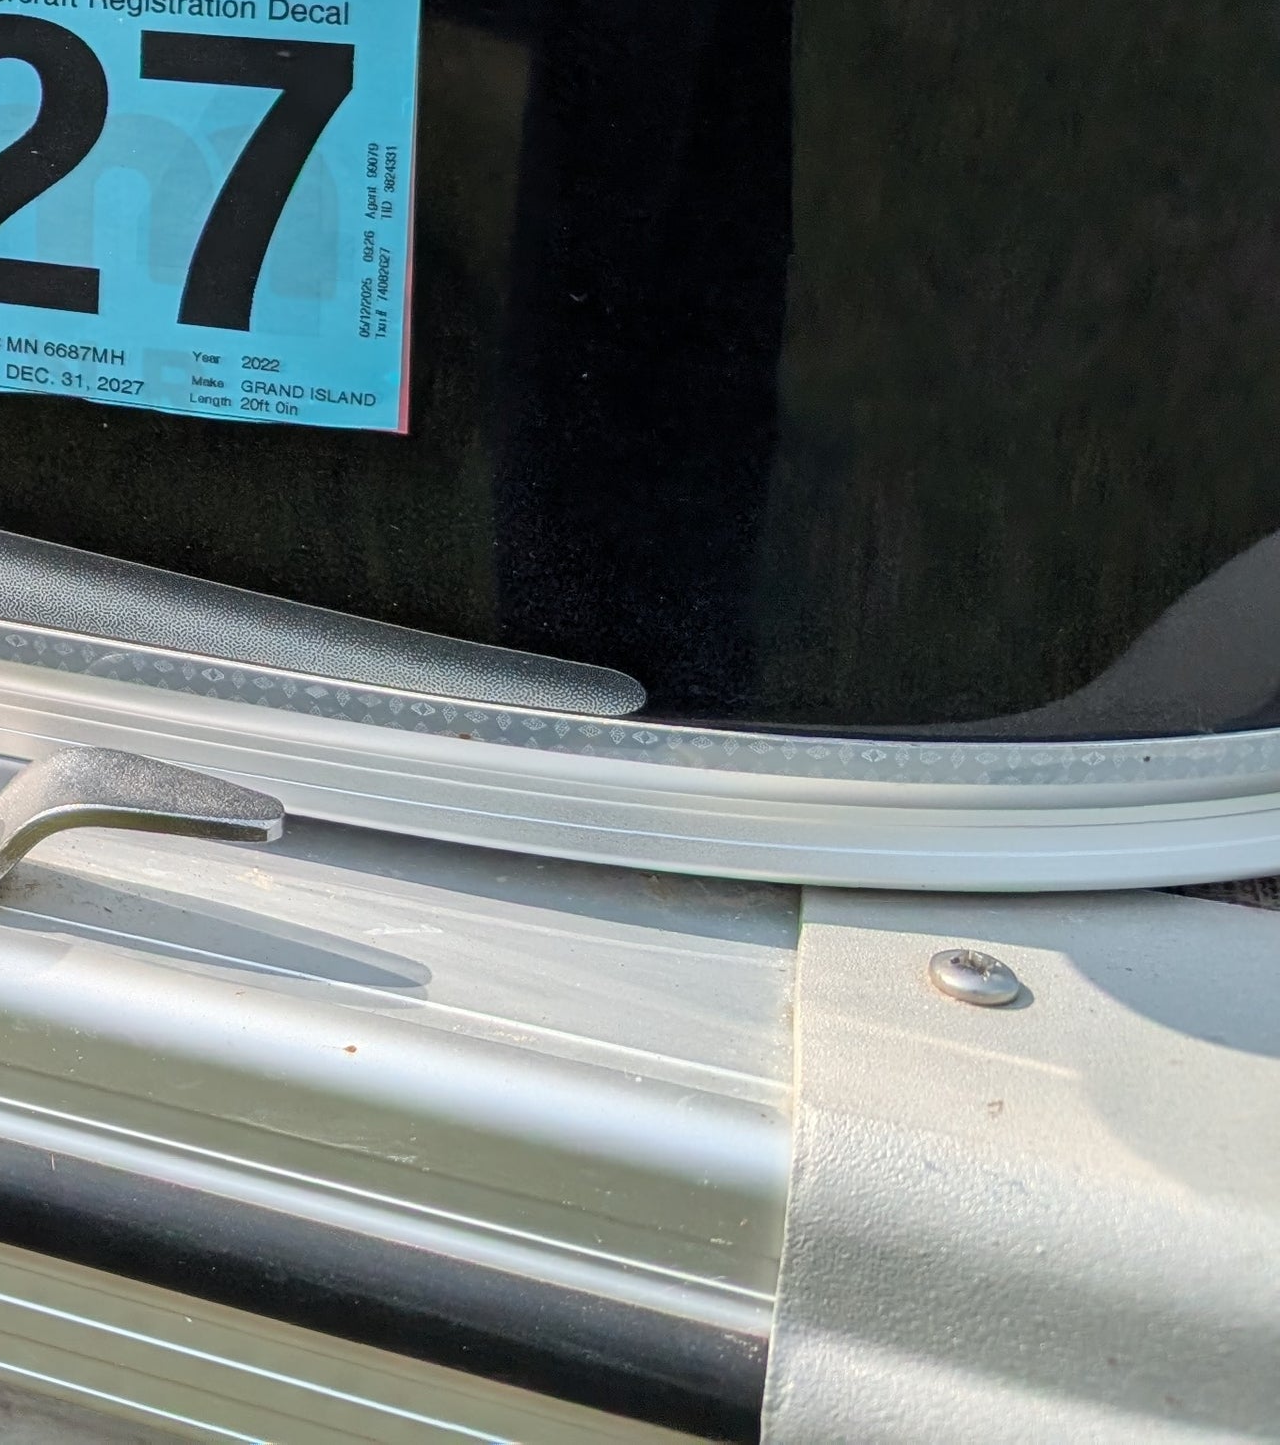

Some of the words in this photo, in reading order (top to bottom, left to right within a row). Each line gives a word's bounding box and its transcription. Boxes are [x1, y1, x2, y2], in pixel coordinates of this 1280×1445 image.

[6, 336, 39, 355] MN
[43, 341, 126, 366] 6687MH
[241, 355, 281, 373] 2022
[6, 363, 54, 386] DEC.
[60, 370, 91, 391] 31,
[96, 376, 146, 396] 2027
[240, 379, 305, 400] GRAND
[310, 386, 377, 407] ISLAND
[240, 397, 271, 413] 20ft
